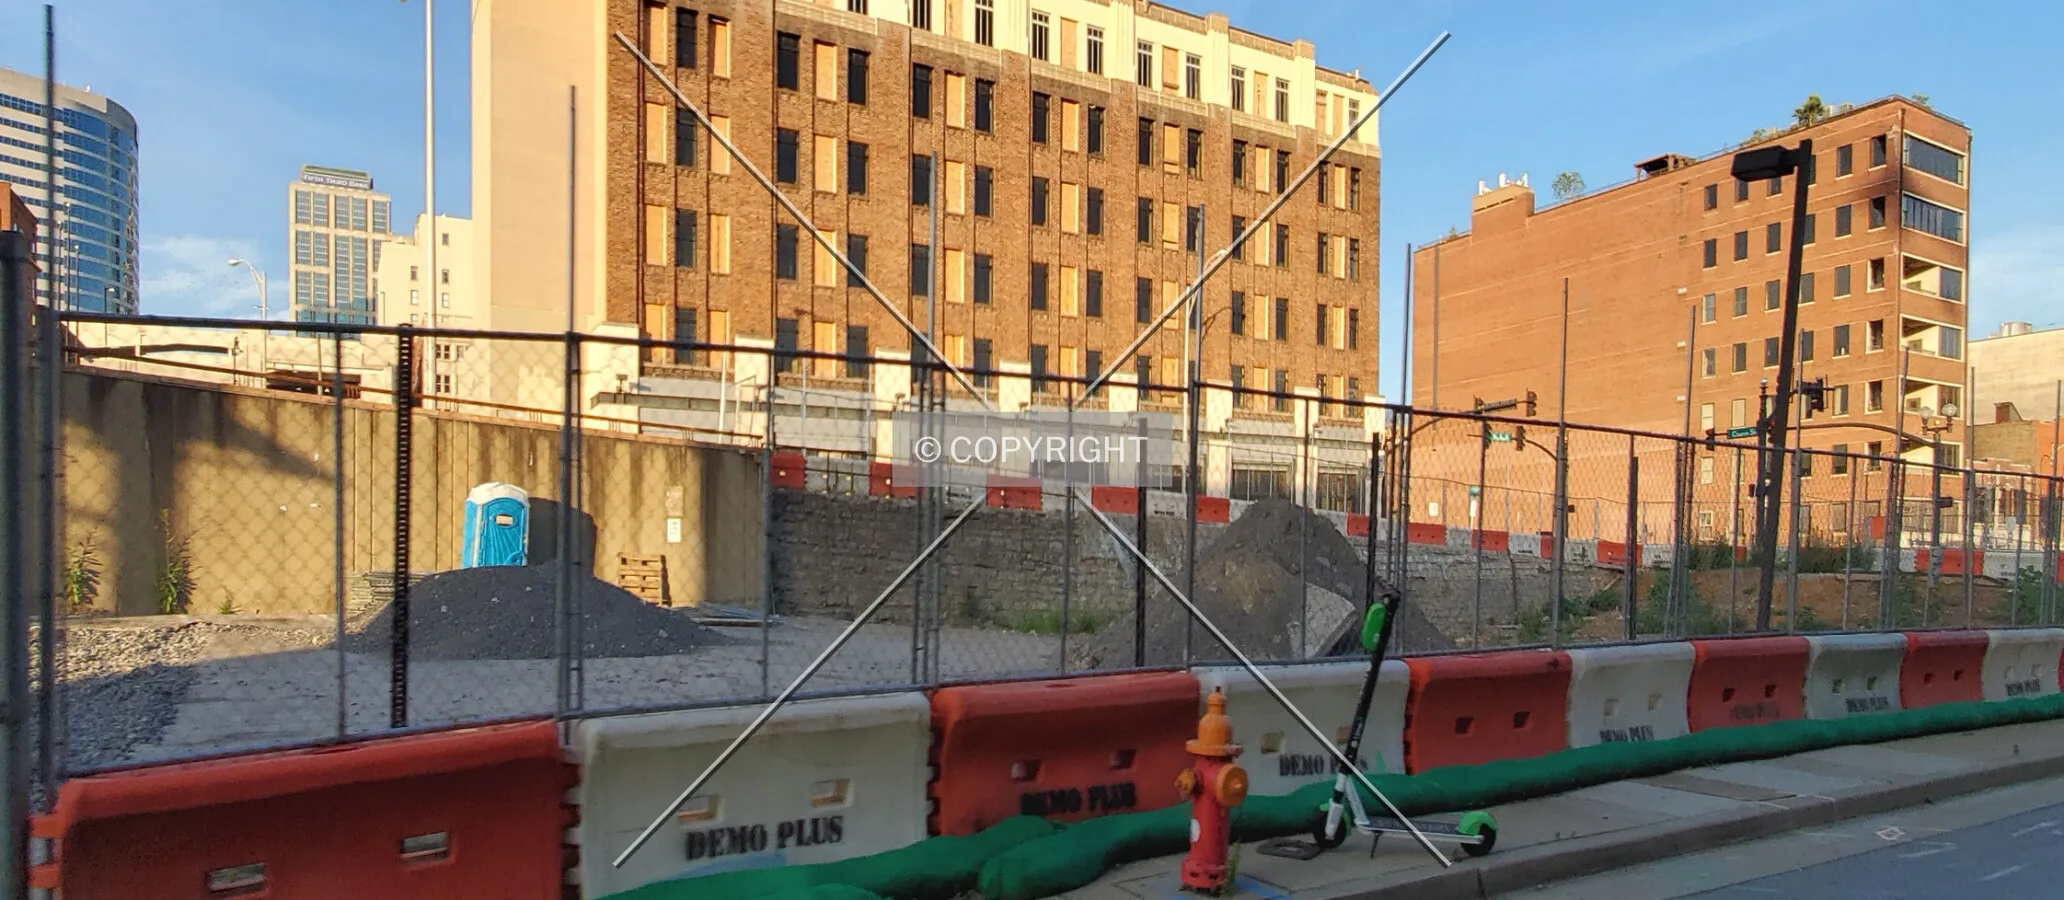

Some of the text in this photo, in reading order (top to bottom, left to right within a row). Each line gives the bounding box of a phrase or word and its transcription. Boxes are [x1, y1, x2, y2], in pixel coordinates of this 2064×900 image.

[303, 174, 369, 190] FIFTH THIRD BANK
[1279, 754, 1325, 776] DEMO
[1020, 783, 1135, 816] DEMO PLUS
[686, 815, 844, 861] DEMO PLUS
